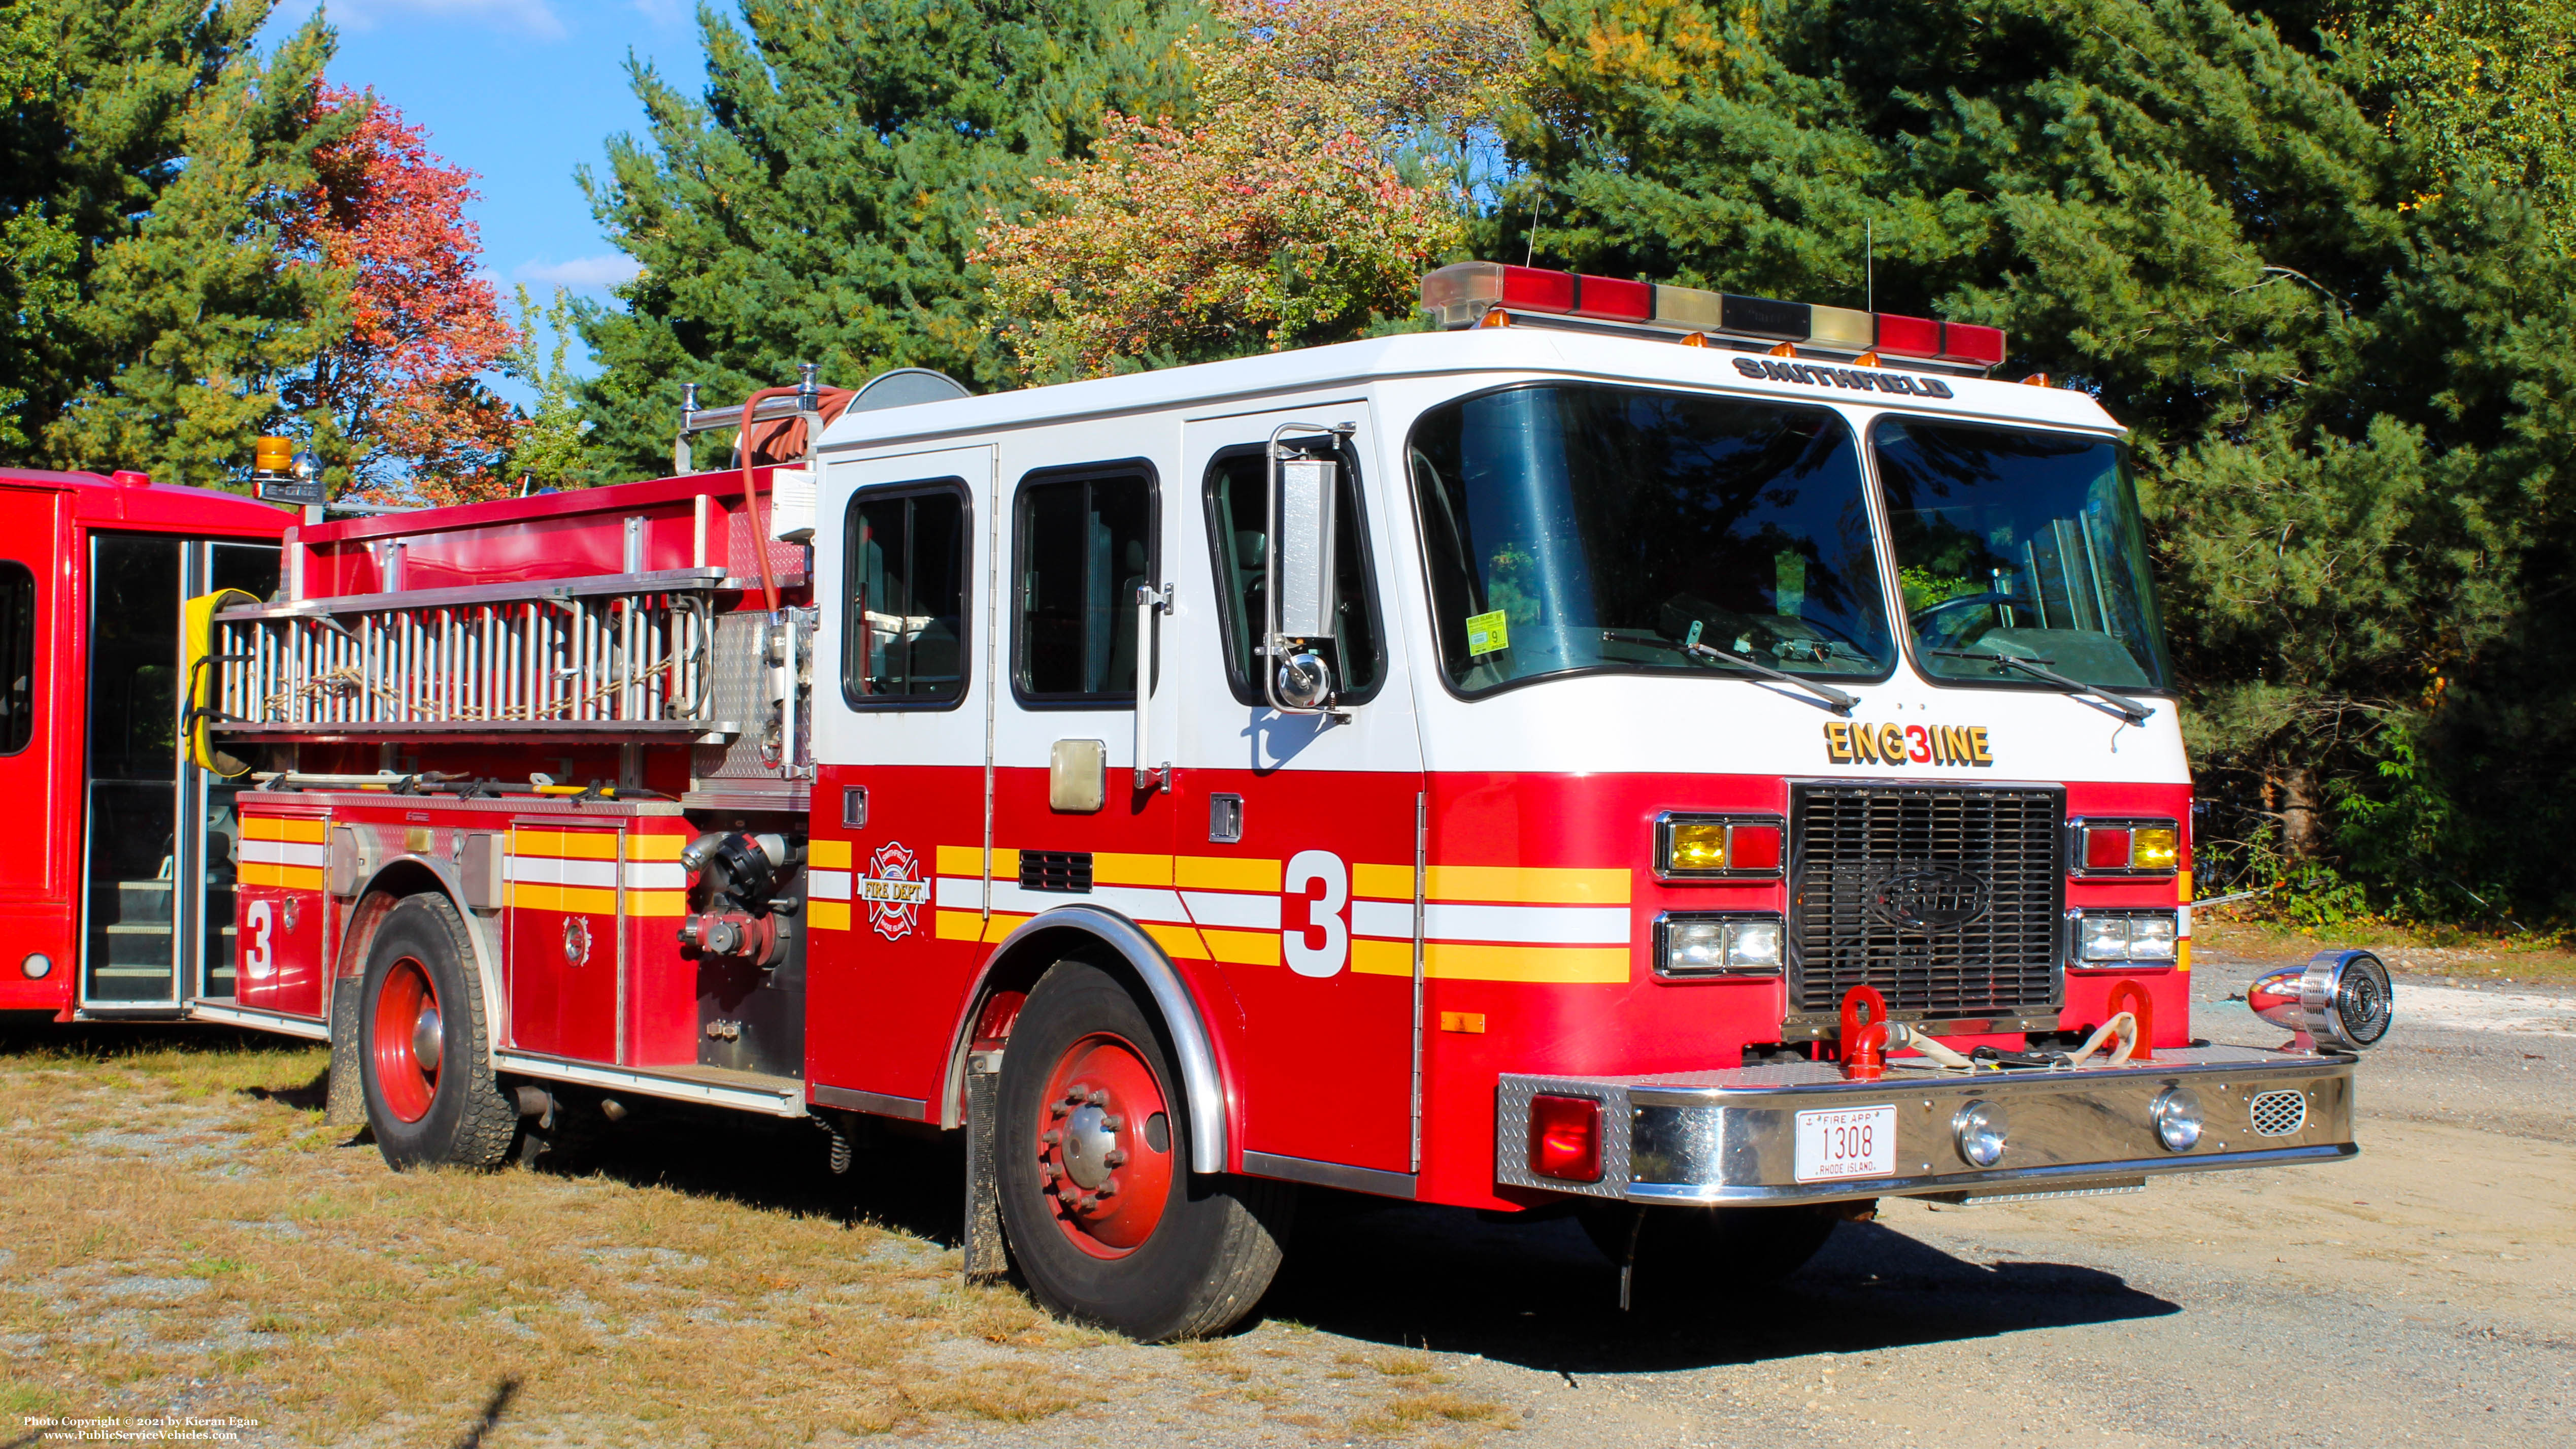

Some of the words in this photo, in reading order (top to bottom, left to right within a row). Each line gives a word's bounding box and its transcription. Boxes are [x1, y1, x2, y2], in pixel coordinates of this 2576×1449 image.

[1732, 357, 1954, 400] SMITHFIELD
[1492, 631, 1498, 643] 9
[882, 849, 907, 863] SMITHFIELD
[865, 881, 889, 899] FIRE
[893, 883, 924, 902] DEPT.
[1283, 849, 1348, 978] 3
[880, 919, 892, 932] RHODE
[892, 921, 905, 932] ISLAND
[246, 900, 272, 979] 3
[1823, 1115, 1847, 1125] FIRE
[1824, 1125, 1872, 1161] 1308
[1820, 1164, 1843, 1175] RHODE
[1847, 1161, 1873, 1173] ISLAND
